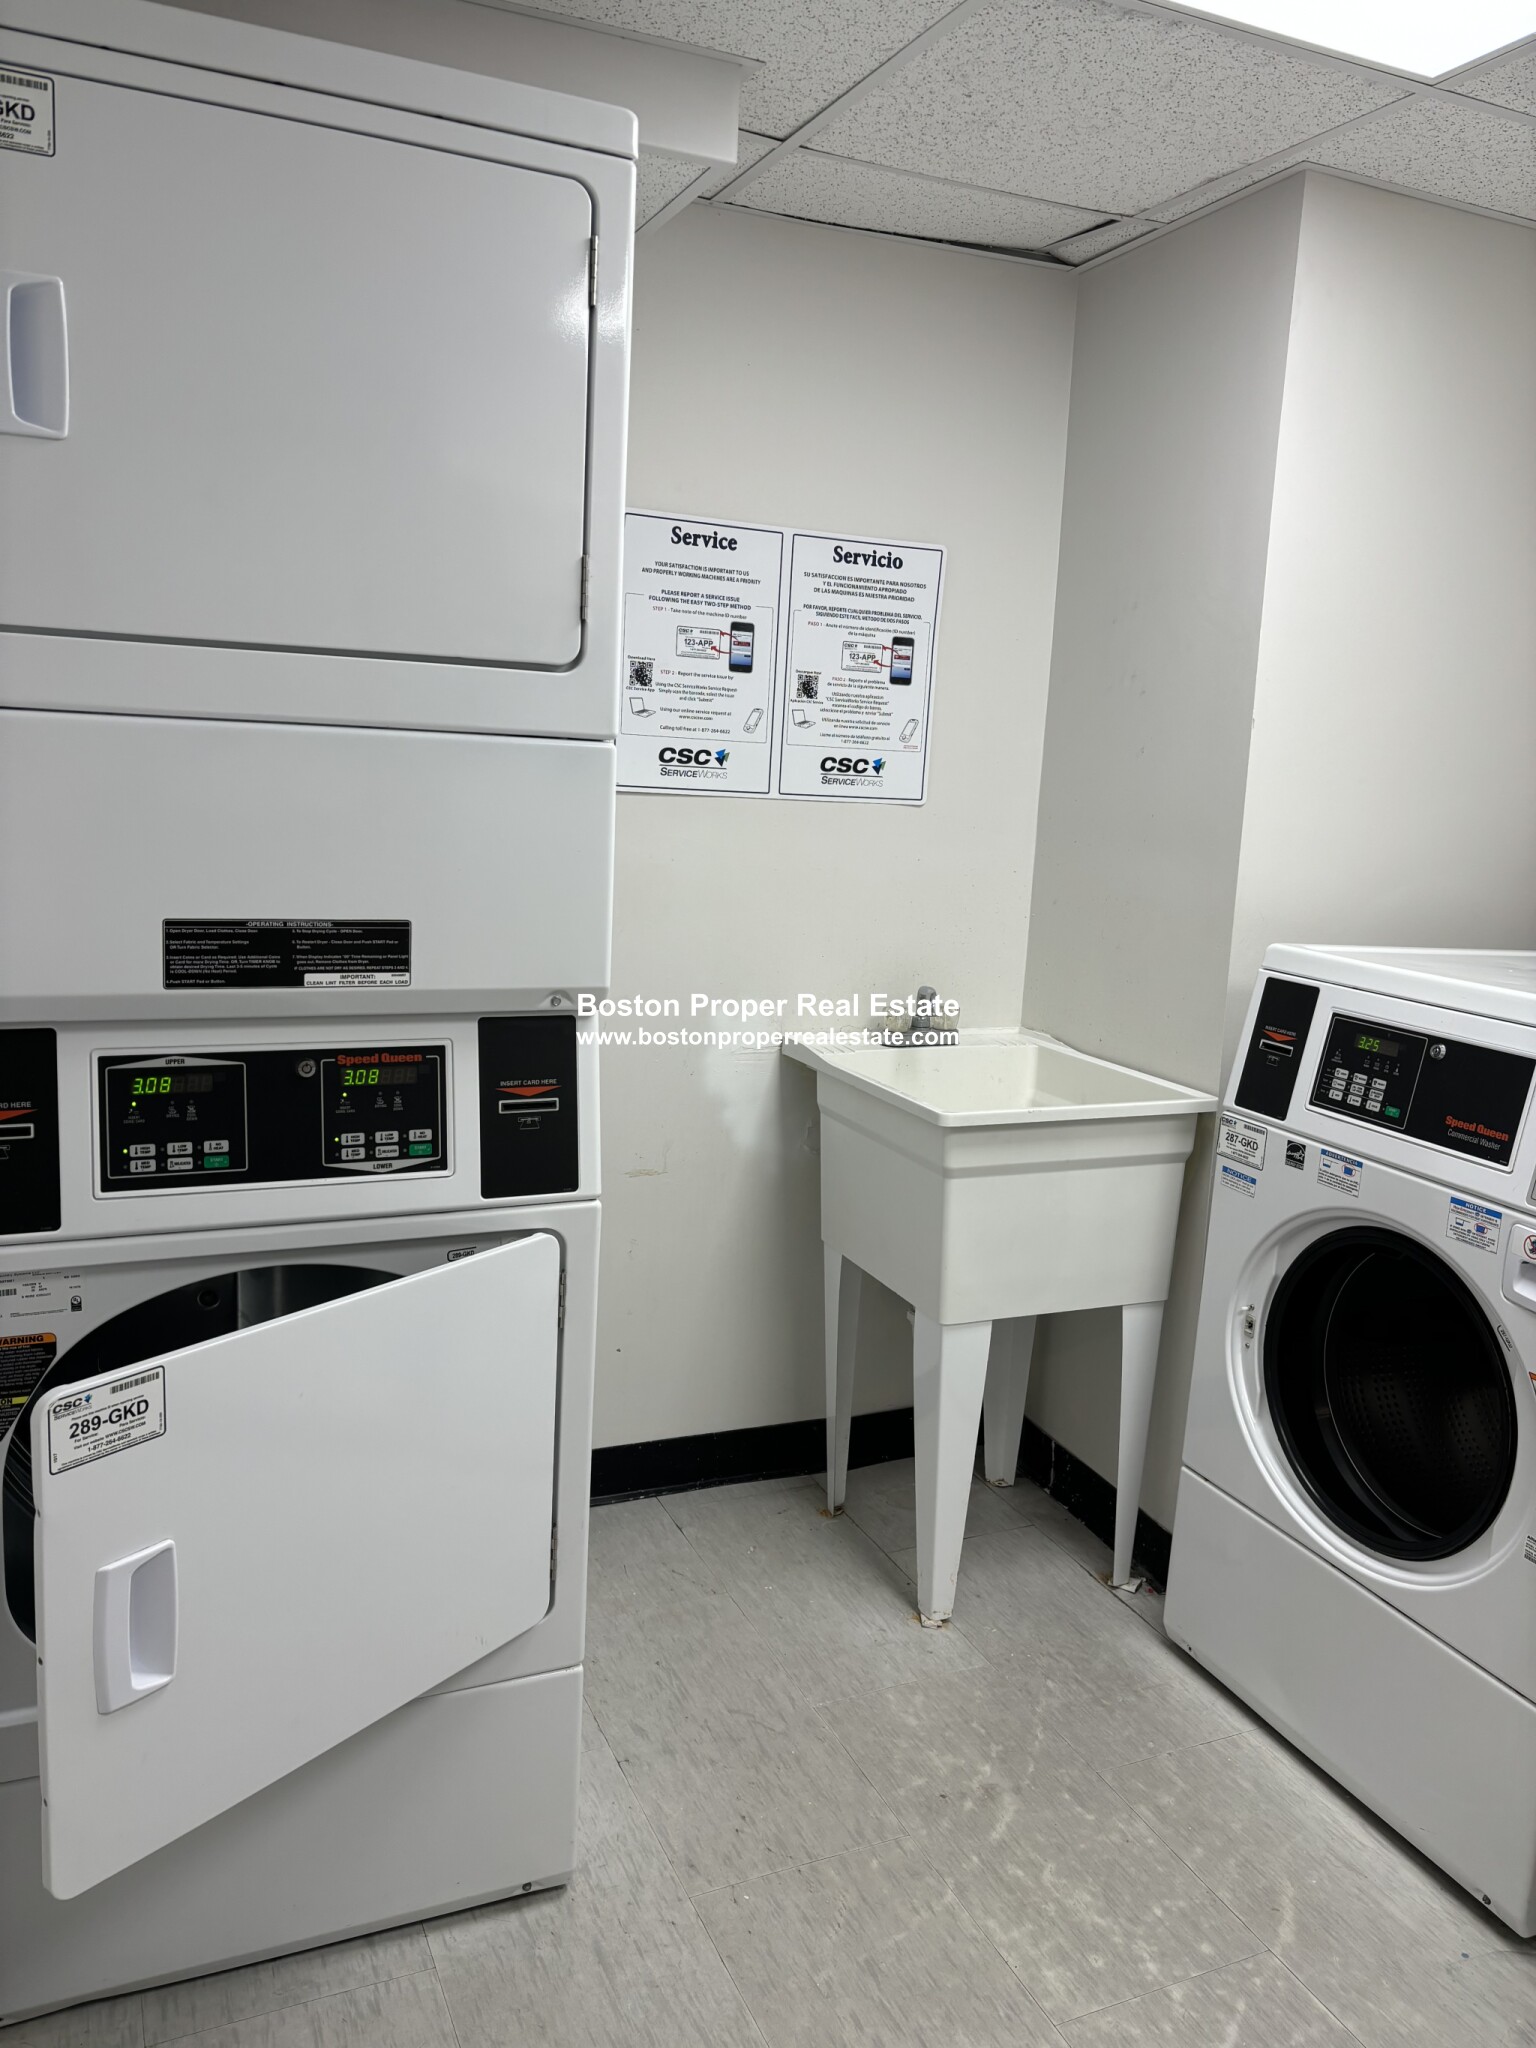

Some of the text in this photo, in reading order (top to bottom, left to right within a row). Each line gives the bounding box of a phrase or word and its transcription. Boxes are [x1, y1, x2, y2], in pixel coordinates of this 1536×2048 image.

[0, 101, 35, 121] KD
[671, 525, 738, 551] Service
[833, 545, 903, 569] Servicio
[653, 568, 677, 576] PROPERLY
[701, 573, 725, 581] MACHINES
[669, 562, 702, 571] SATISFACTION
[811, 572, 847, 581] SATISFACCION
[854, 577, 885, 585] IMPORTANTE
[833, 582, 878, 591] FUNCIONAMIENTO
[649, 595, 679, 603] FOLLOWING
[831, 589, 858, 597] MAQUINAS
[865, 592, 887, 600] NUESTRA
[684, 637, 714, 647] 123-APP
[849, 653, 877, 661] 123-APP
[658, 747, 712, 765] CSC
[820, 757, 869, 774] CSC
[1357, 1036, 1380, 1052] 3.25
[337, 1053, 423, 1066] Speed Queen
[344, 1068, 379, 1086] 3.08
[132, 1076, 172, 1095] 3.08
[1445, 1115, 1509, 1142] Speed Queen
[1225, 1131, 1259, 1151] 287-GKD
[1447, 1128, 1501, 1151] Commercial Washer
[1227, 1168, 1252, 1182] NOTICE
[1465, 1202, 1487, 1214] NOTICE
[53, 1398, 83, 1415] CSC
[69, 1398, 149, 1439] 289-GKD
